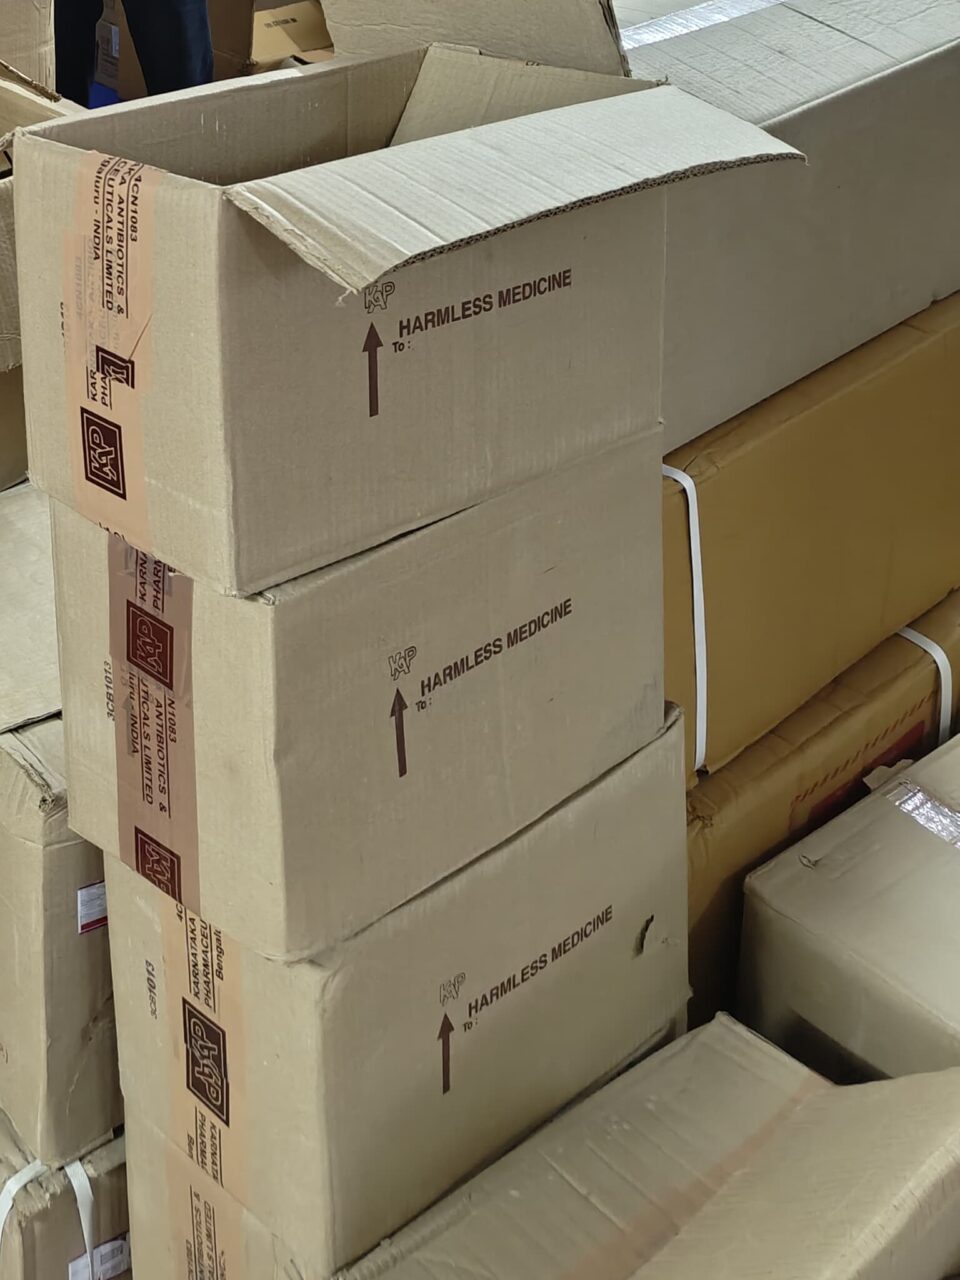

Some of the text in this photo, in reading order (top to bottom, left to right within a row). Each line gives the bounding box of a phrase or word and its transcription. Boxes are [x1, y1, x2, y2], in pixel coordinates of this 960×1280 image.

[93, 218, 102, 261] INDIA
[130, 173, 143, 242] 4CN1083
[116, 194, 126, 297] ANTIBIOTICS
[105, 249, 114, 312] LIMITED
[116, 303, 124, 315] &
[398, 269, 573, 338] HARMLESS MEDICINE
[421, 598, 573, 697] HARMLESS MEDICINE
[103, 660, 116, 721] 3CB1013
[129, 715, 140, 754] INDIA
[155, 697, 167, 813] ANTIBIOTICS &
[143, 748, 153, 806] LIMITED
[189, 917, 200, 1001] KARNATAKA
[467, 904, 613, 1018] HARMLESS MEDICINE
